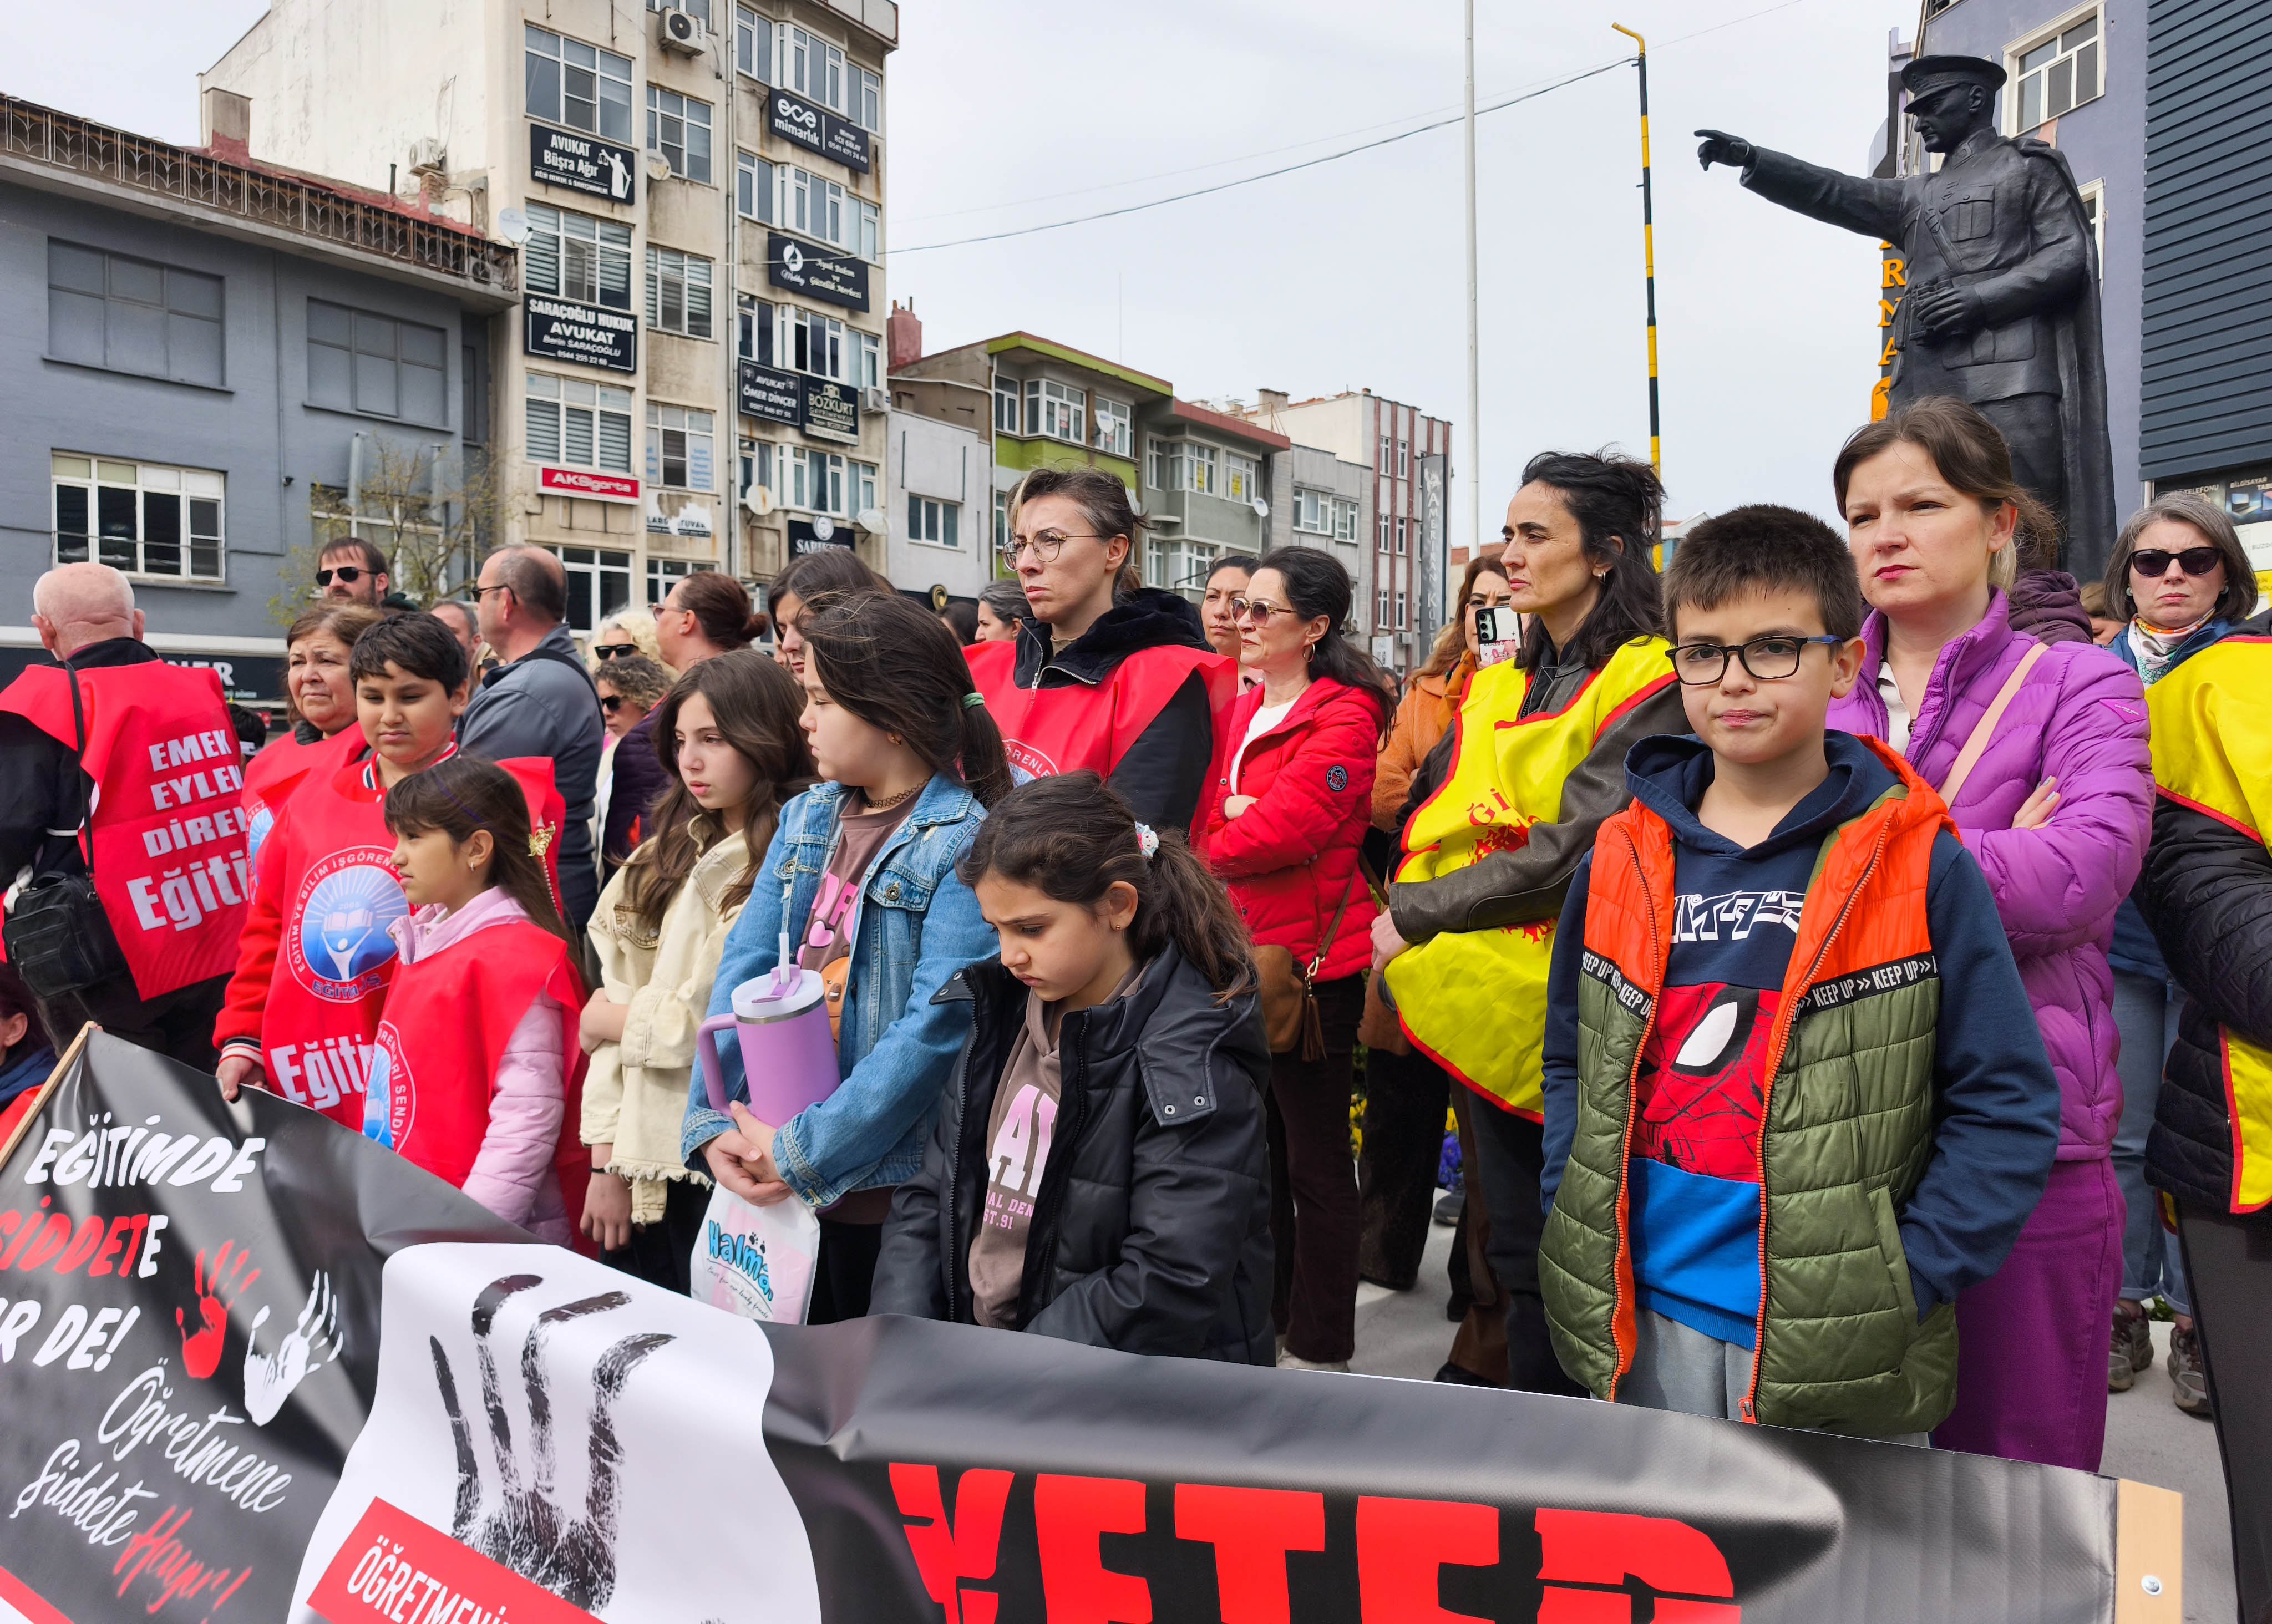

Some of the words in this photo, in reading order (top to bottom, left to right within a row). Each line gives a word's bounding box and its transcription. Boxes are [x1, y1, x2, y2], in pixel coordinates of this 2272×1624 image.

[778, 99, 816, 128] ece
[550, 134, 590, 157] AVUKAT
[774, 118, 819, 146] mimarlık
[544, 149, 575, 171] Büşra
[577, 159, 599, 178] Ağır
[529, 298, 595, 324] SARAÇOĞLU
[598, 313, 634, 332] HUKUK
[550, 322, 615, 345] AVUKAT
[567, 339, 621, 357] SARAÇOĞLU
[743, 384, 767, 400] ÖMER
[768, 390, 797, 408] DİNÇER
[755, 375, 785, 390] AVUKAT
[808, 393, 854, 415] BOZKURT
[552, 473, 631, 493] AKSigorta
[2230, 476, 2268, 488] BİLGİSAYAR
[301, 865, 329, 900] BİLİM
[294, 904, 303, 921] VE
[292, 926, 306, 973] EĞİTİM
[1583, 951, 1599, 973] KEEP
[1598, 961, 1614, 980] UP
[1618, 983, 1644, 1009] KEEP
[1812, 984, 1838, 1007] KEEP
[1839, 978, 1854, 999] UP
[1871, 966, 1903, 989] KEEP
[1903, 960, 1918, 981] UP
[24, 1112, 265, 1193] EĞİTİMDE
[32, 1305, 141, 1372] DE!
[98, 1358, 292, 1512] Öğretmene
[9, 1439, 159, 1546] Şiddete
[889, 1462, 1742, 1624] YETER
